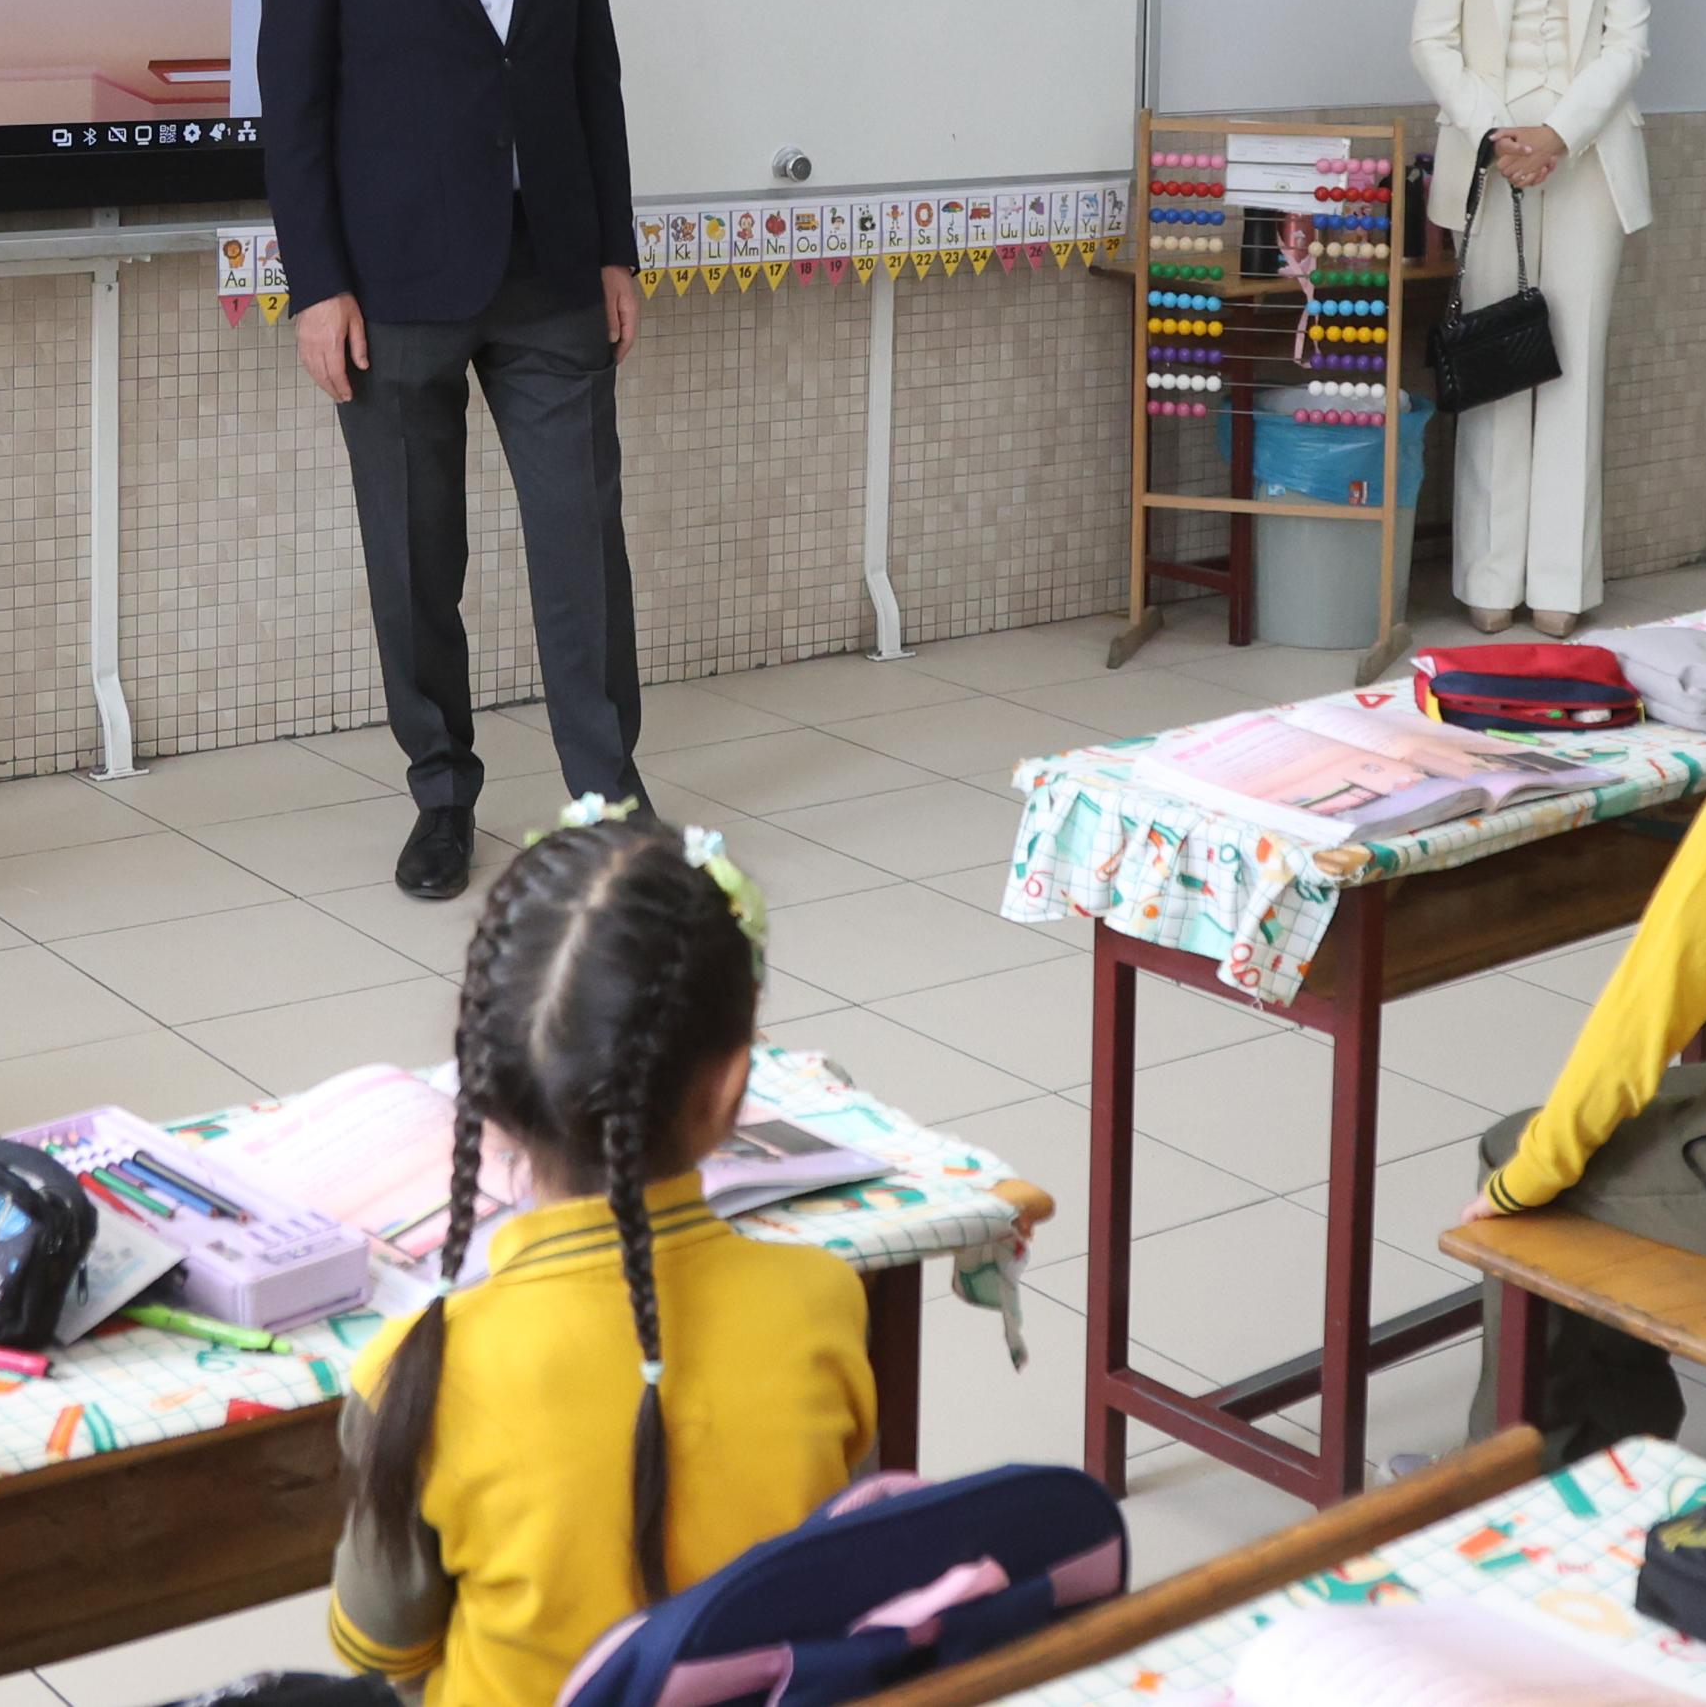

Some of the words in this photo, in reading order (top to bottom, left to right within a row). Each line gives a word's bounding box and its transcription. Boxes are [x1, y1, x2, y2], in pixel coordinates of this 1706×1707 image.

[225, 270, 246, 287] Aa
[644, 246, 656, 268] Jj
[674, 244, 691, 260] Kk
[733, 241, 759, 257] Mm
[766, 238, 785, 255] Nn
[796, 236, 817, 253] Oo
[826, 230, 847, 251] Öö
[859, 233, 874, 255] Pp
[889, 231, 902, 246] Rr
[917, 228, 931, 244] Ss
[973, 225, 985, 240] Tt
[1000, 223, 1018, 239] Uu
[1054, 220, 1070, 235] Vv
[1081, 219, 1096, 239] Yy
[1108, 215, 1121, 231] Zz
[232, 298, 239, 312] 1
[267, 296, 278, 310] 2
[644, 271, 657, 284] 13
[676, 270, 688, 282] 14
[708, 268, 720, 280] 15
[739, 266, 752, 279] 16
[769, 264, 782, 276] 17
[800, 262, 812, 274] 18
[830, 260, 842, 272] 19
[858, 258, 874, 270] 20
[889, 256, 901, 267] 21
[916, 254, 931, 266] 22
[945, 252, 959, 264] 23
[972, 250, 987, 261] 24
[1002, 247, 1016, 258] 25
[1029, 245, 1042, 257] 26
[1055, 244, 1069, 255] 27
[1082, 242, 1095, 253] 28
[1106, 239, 1120, 251] 29
